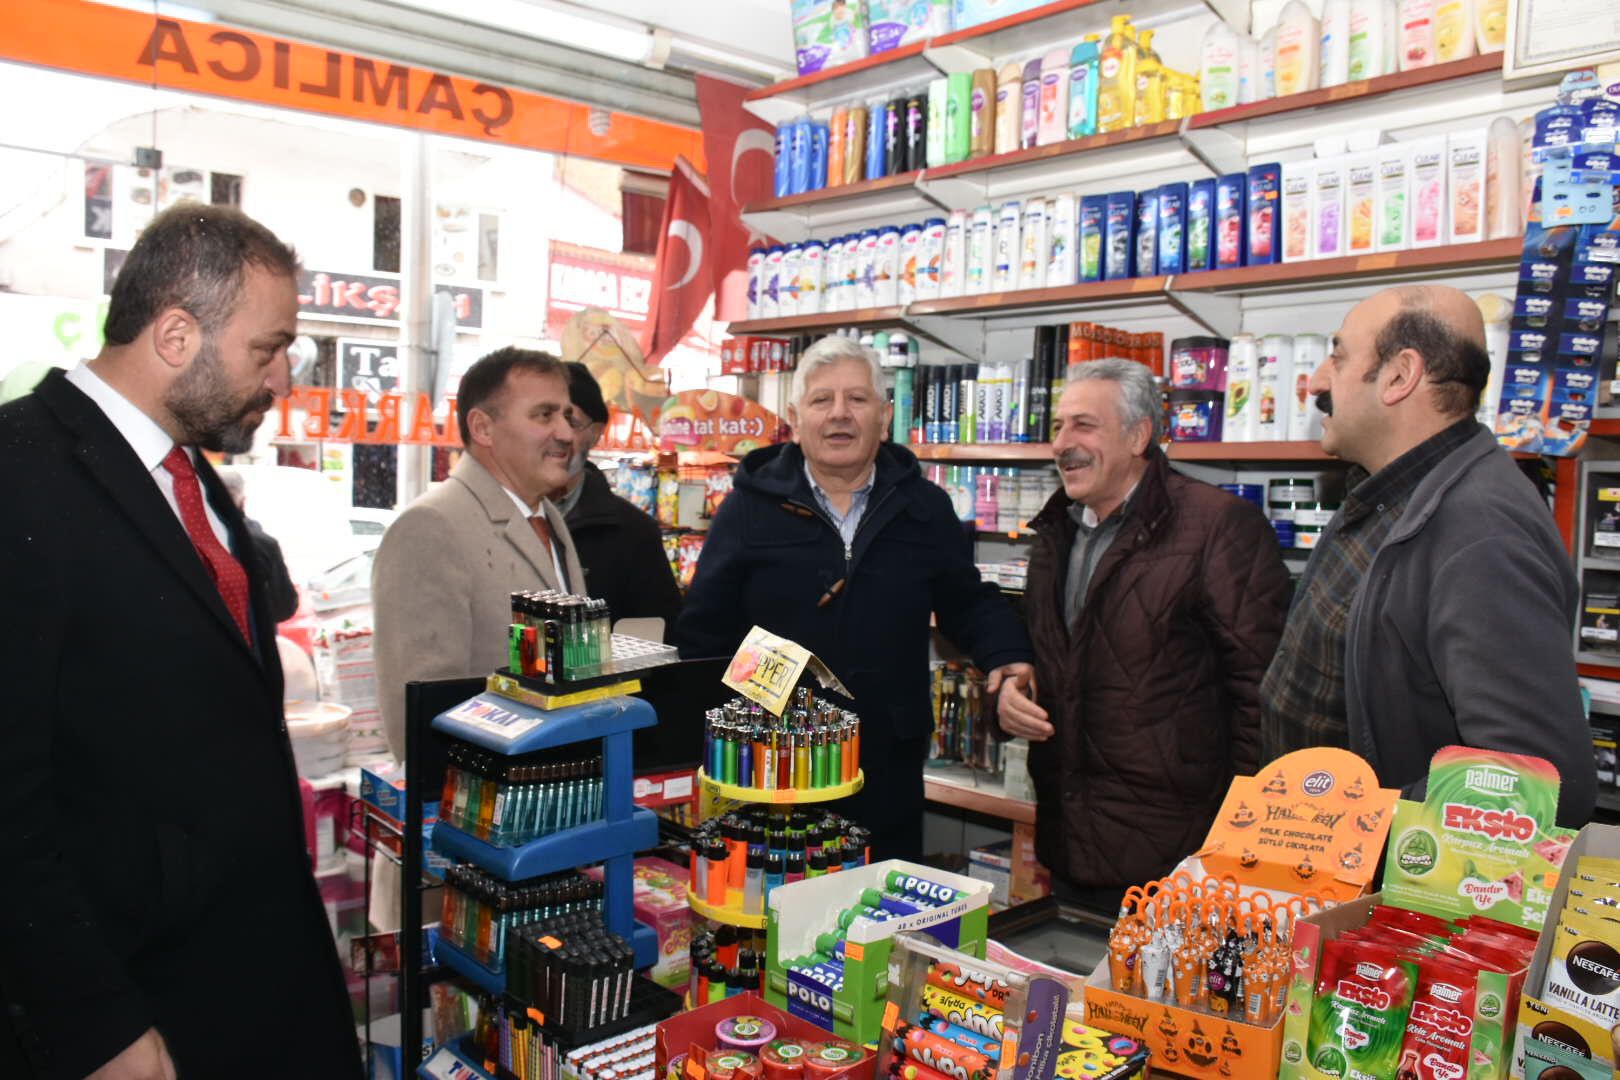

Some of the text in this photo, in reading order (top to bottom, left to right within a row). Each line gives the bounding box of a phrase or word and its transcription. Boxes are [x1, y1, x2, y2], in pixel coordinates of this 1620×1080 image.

[1414, 153, 1441, 165] CLEAR
[694, 419, 714, 435] tat
[719, 418, 748, 435] kat
[1304, 773, 1329, 791] elit
[1465, 768, 1519, 793] palmer
[1260, 826, 1334, 843] MILK CHOCOLATE
[905, 876, 953, 902] POLO
[916, 911, 949, 925] ORIGINAL
[1209, 975, 1222, 986] elit
[788, 982, 830, 1012] POLO
[1548, 981, 1588, 1008] VANILLA
[1591, 998, 1620, 1020] LATTE
[1025, 1032, 1045, 1080] onibon
